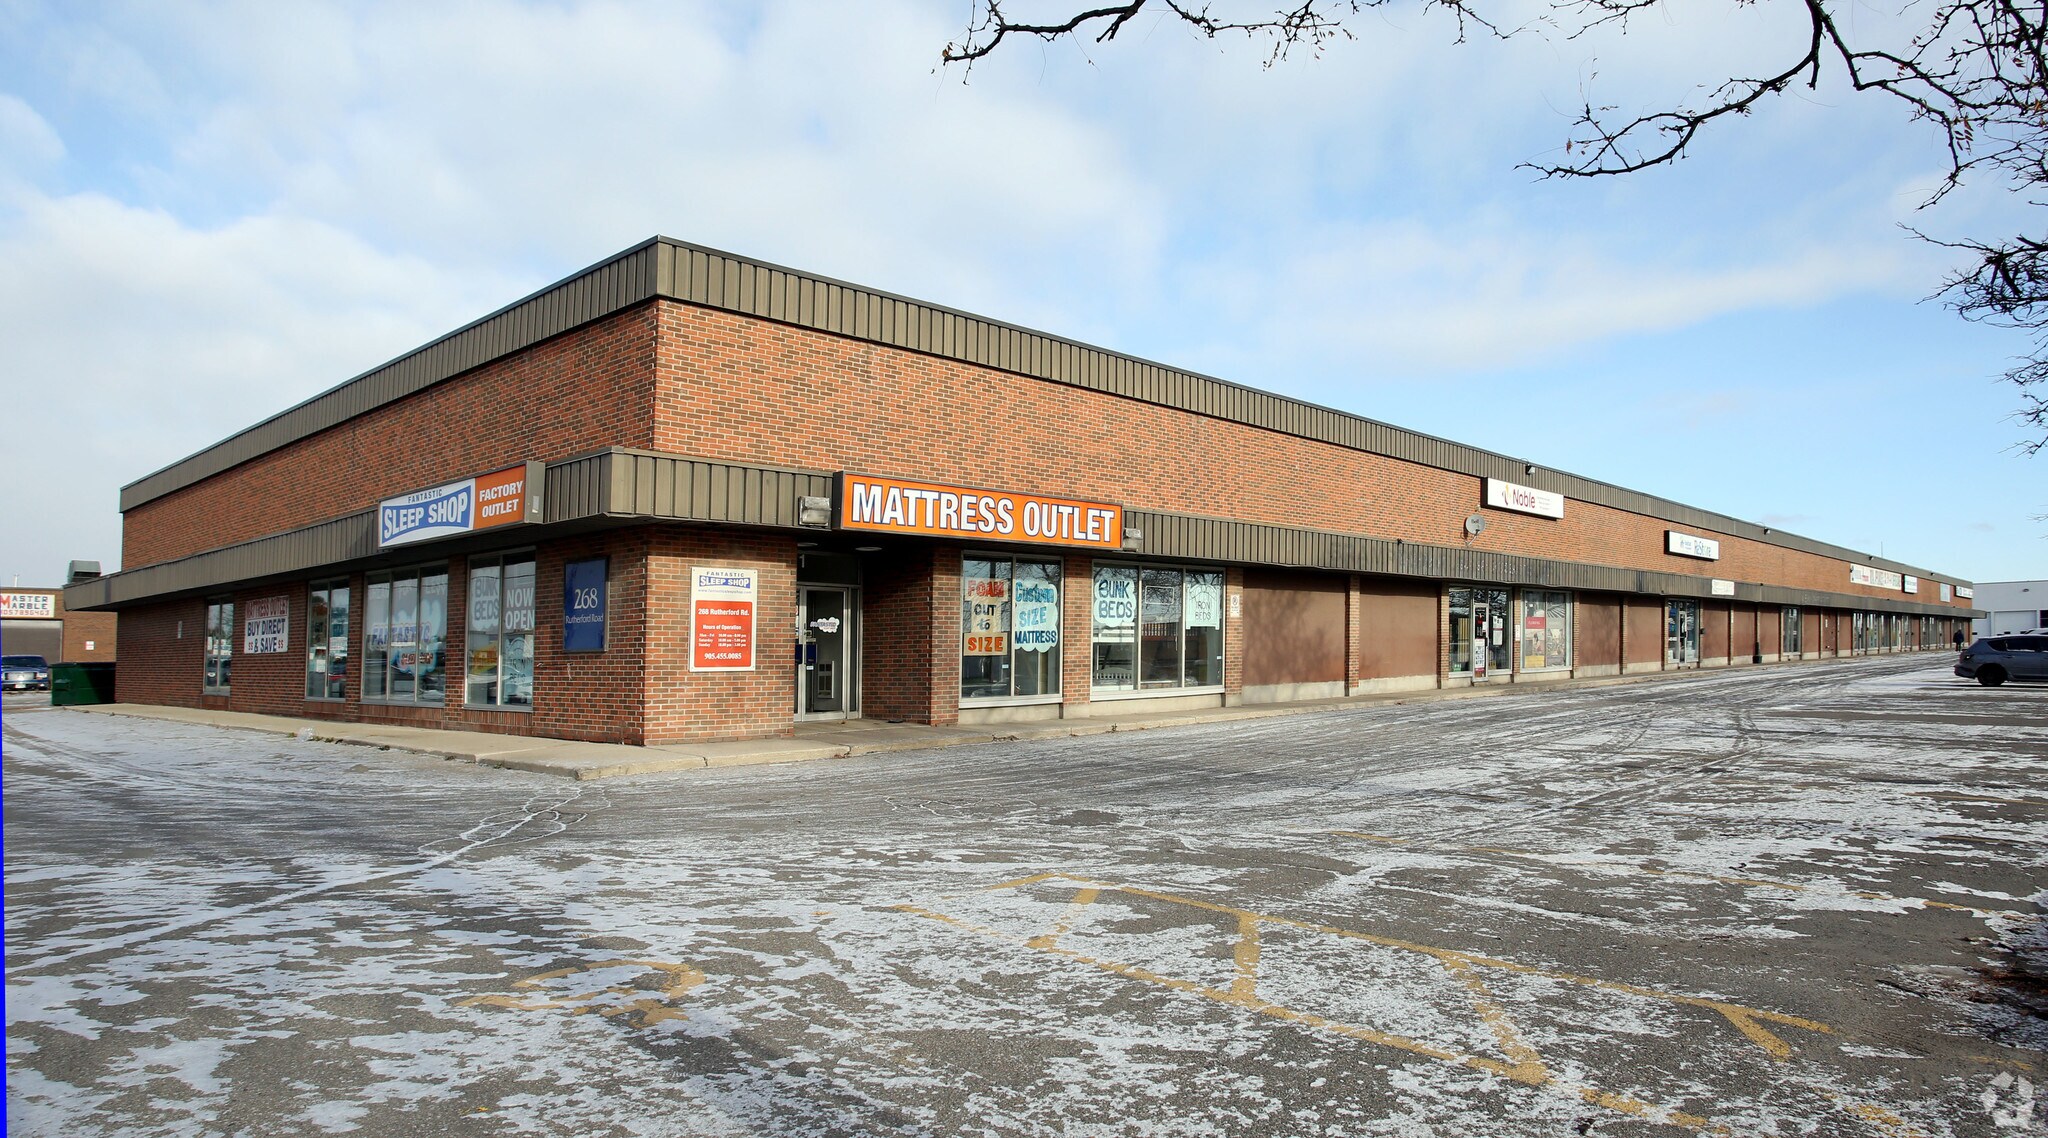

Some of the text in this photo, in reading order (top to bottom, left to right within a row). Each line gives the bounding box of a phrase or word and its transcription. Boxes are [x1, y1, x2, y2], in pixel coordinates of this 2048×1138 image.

[408, 488, 443, 503] FANTASTIC
[479, 480, 523, 502] FACTORY
[1512, 489, 1536, 509] Noble
[384, 491, 468, 539] SLEEP SHOP
[482, 499, 519, 518] OUTLET
[851, 482, 1115, 543] MATTRESS OUTLET
[475, 578, 499, 598] BUNK
[699, 576, 749, 588] SLEEP SHOP
[967, 580, 1004, 597] FOAM
[1098, 578, 1130, 599] BUNK
[506, 587, 534, 608] NOW
[573, 587, 598, 609] 268
[1015, 581, 1055, 603] Custom
[475, 599, 499, 620] BEDS
[974, 603, 996, 616] CUT
[1098, 600, 1133, 619] BEDS
[1195, 600, 1211, 610] IRON
[505, 609, 535, 630] OPEN
[565, 613, 604, 624] Rutherford Road
[977, 618, 991, 631] to
[1019, 606, 1047, 627] SIZE
[1194, 611, 1212, 621] BEDS
[247, 618, 286, 636] BUY DIRECT
[254, 638, 259, 653] &
[260, 636, 277, 652] SAVE
[967, 636, 1004, 652] SIZE
[1014, 630, 1057, 644] MATTRESS
